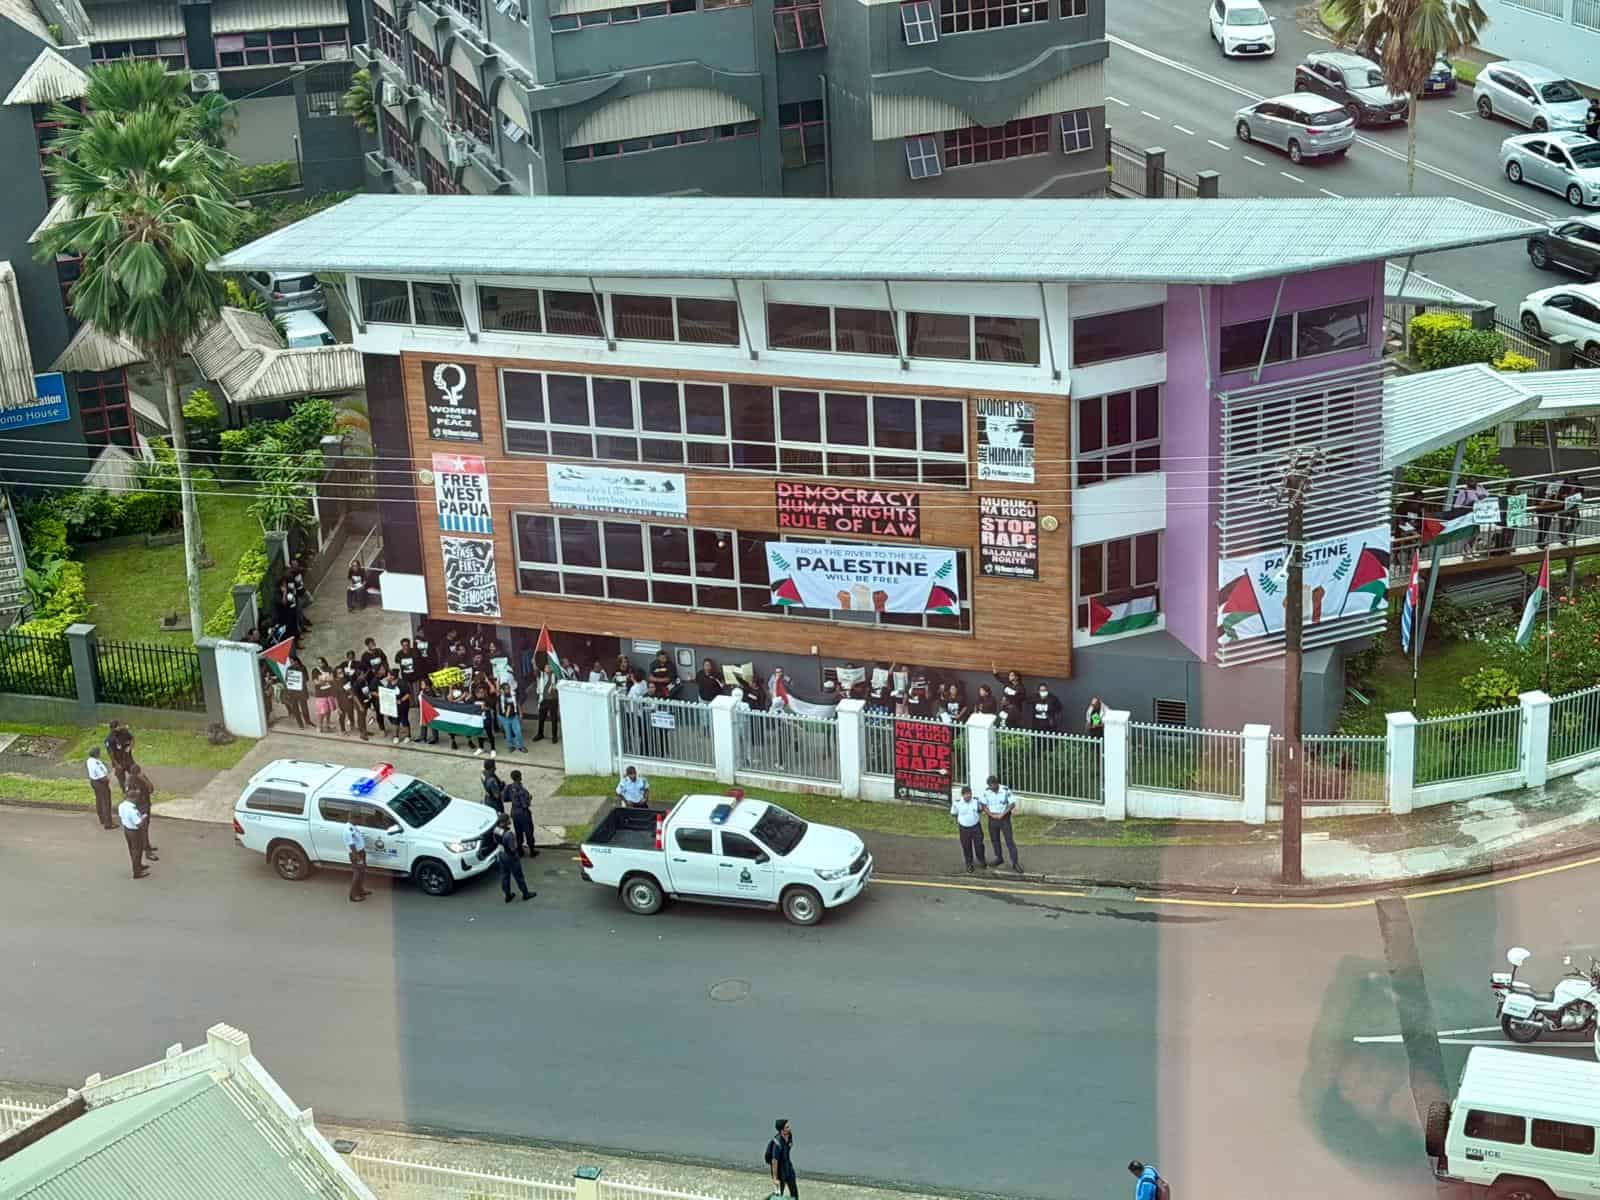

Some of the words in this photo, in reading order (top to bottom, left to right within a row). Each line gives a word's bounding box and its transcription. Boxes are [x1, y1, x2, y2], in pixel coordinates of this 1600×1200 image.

[26, 408, 59, 420] House
[429, 406, 477, 416] WOMEN
[436, 418, 473, 428] PEACE
[988, 448, 1024, 467] HUMAN
[442, 473, 481, 488] FREE
[442, 486, 483, 502] WEST
[778, 483, 915, 506] DEMOCRACY
[439, 499, 490, 517] PAPUA
[778, 498, 844, 516] HUMAN
[851, 504, 916, 522] RIGHTS
[780, 513, 827, 529] RULE
[835, 518, 863, 532] OF
[871, 520, 916, 536] LAW
[981, 517, 1036, 534] STOP
[981, 531, 1037, 548] RAPE
[796, 547, 822, 555] FROM
[845, 550, 872, 558] RIVER
[874, 551, 886, 559] TO
[888, 552, 906, 560] THE
[1265, 543, 1348, 571] PASTINE
[796, 556, 929, 577] PALESTINE
[825, 574, 851, 582] WILL
[855, 575, 869, 583] BE
[872, 576, 899, 585] FREE
[896, 740, 951, 759] STOP
[896, 755, 951, 769] RAPE
[1465, 1147, 1502, 1158] POLICE
